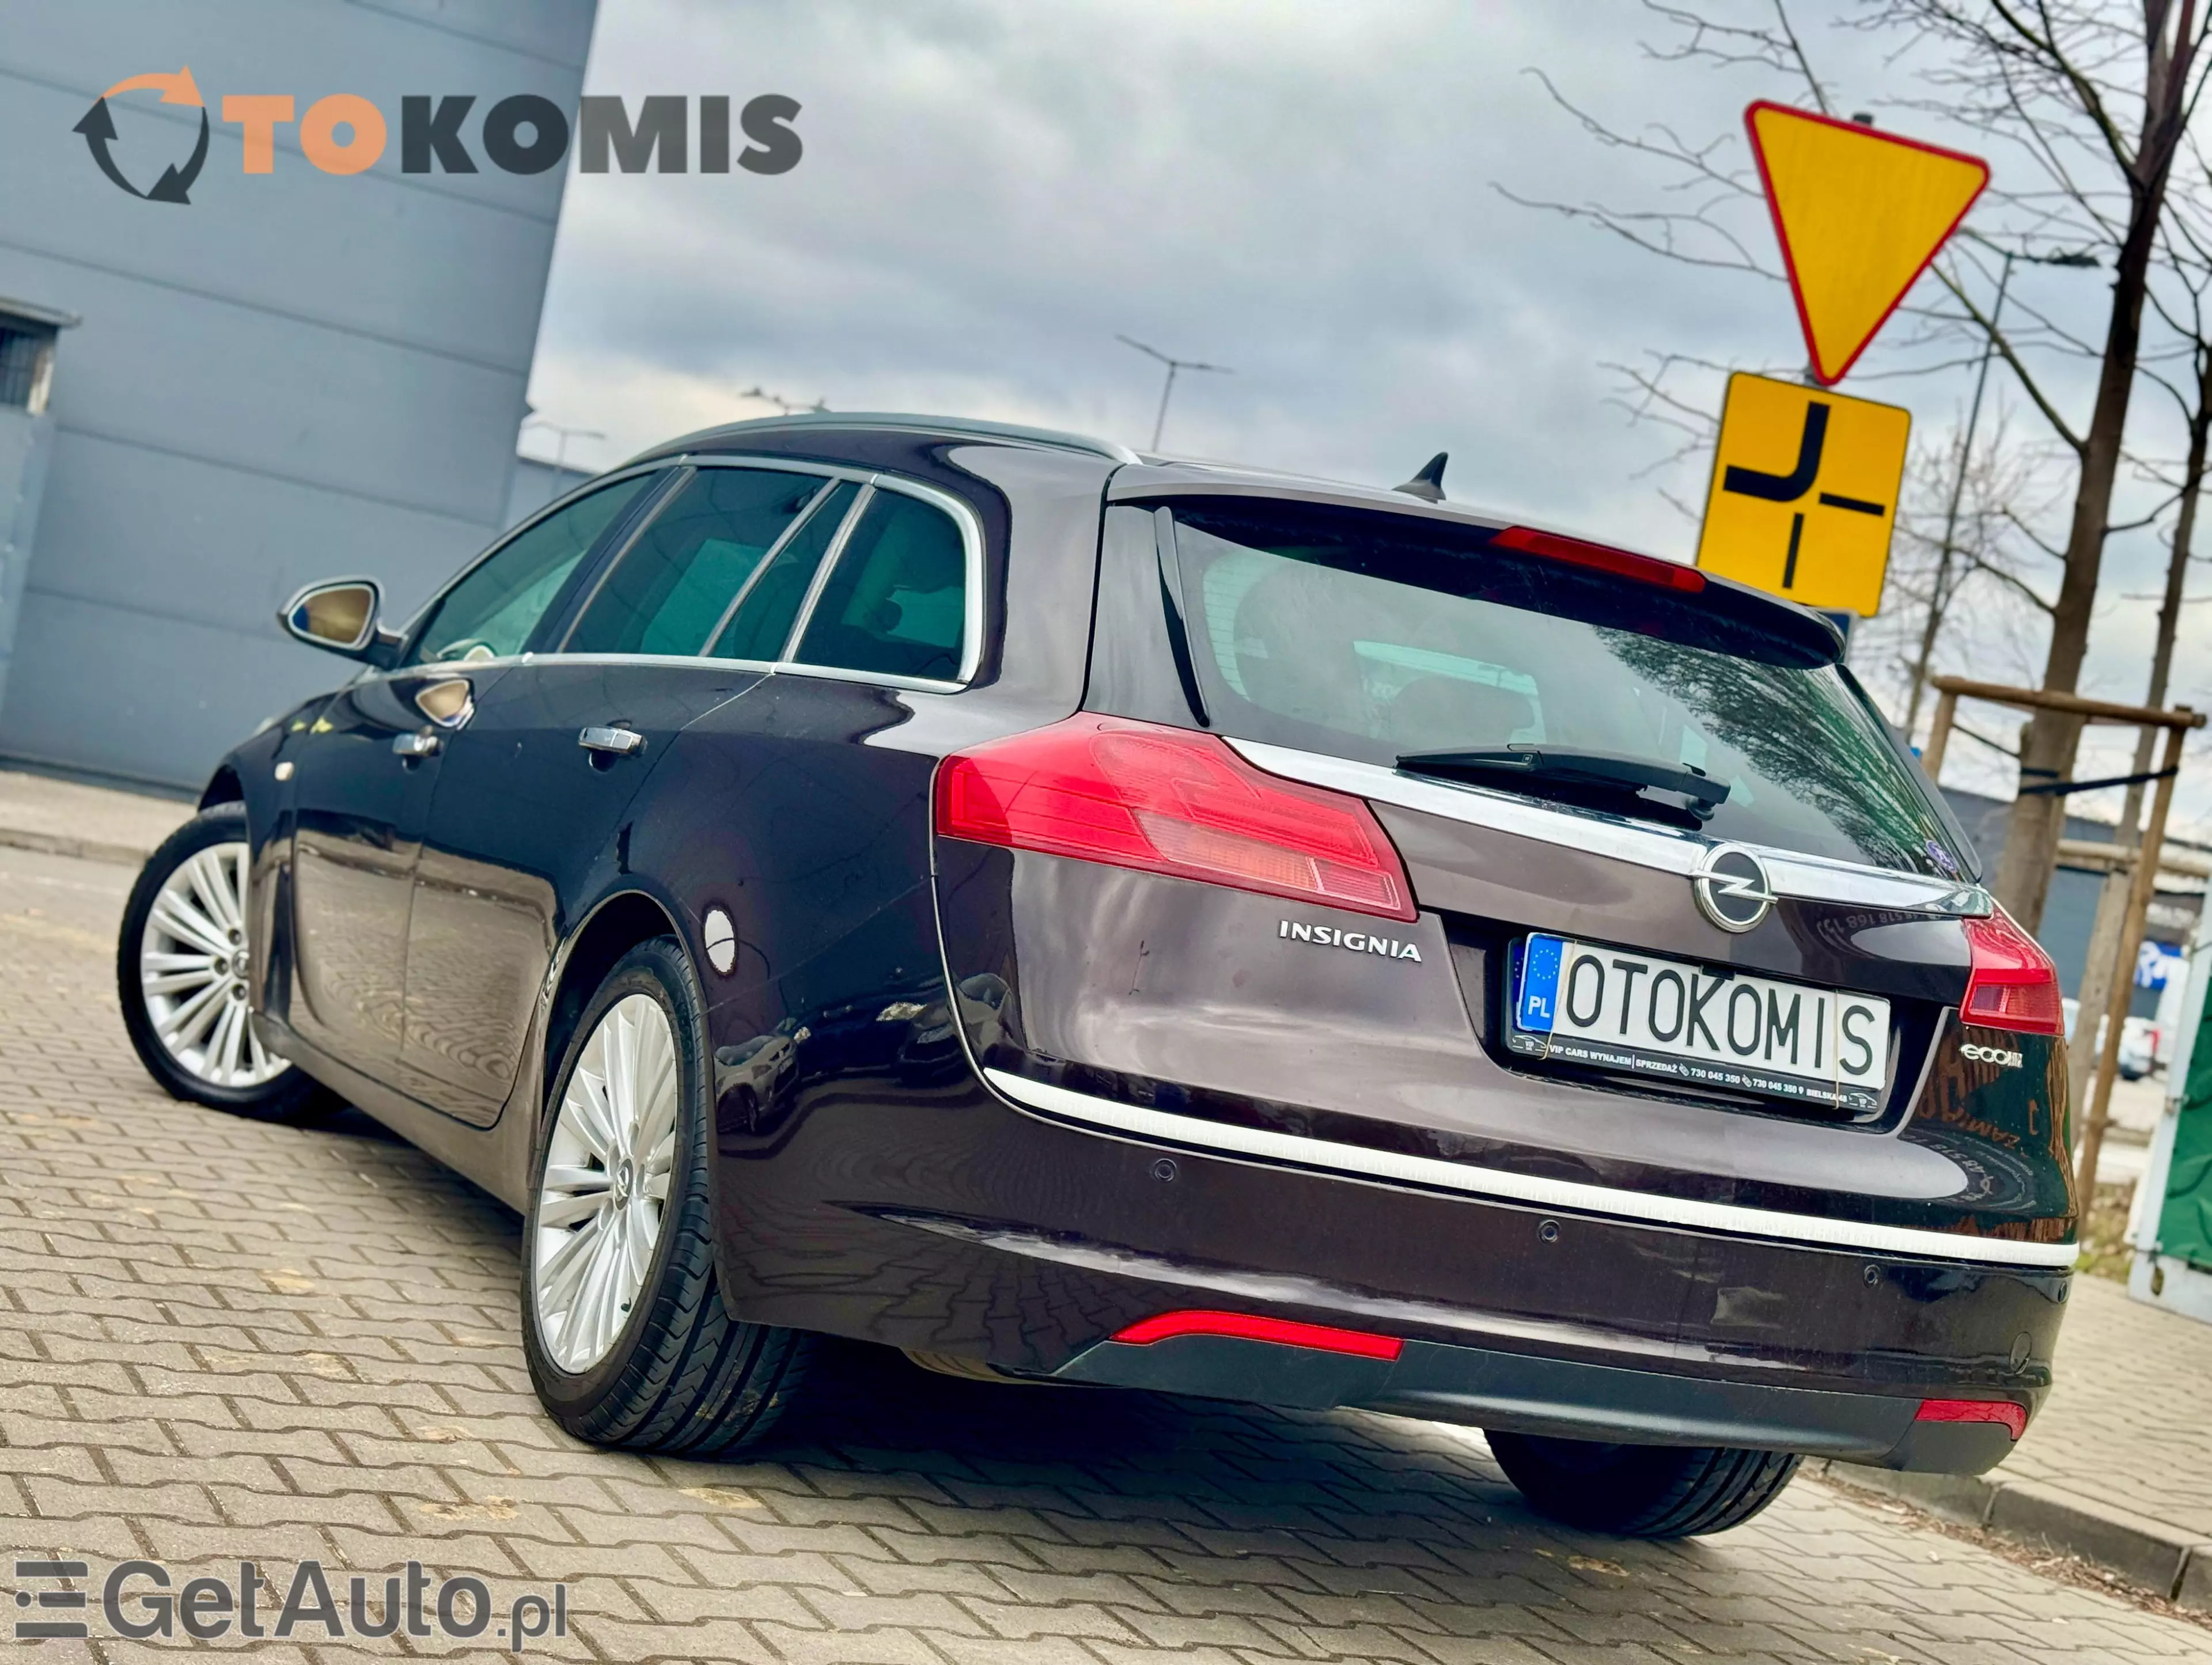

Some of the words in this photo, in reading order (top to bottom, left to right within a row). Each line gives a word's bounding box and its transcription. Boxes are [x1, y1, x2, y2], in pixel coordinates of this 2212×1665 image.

[1279, 920, 1422, 962] INSIGNIA
[1528, 995, 1550, 1018] PL
[1566, 954, 1876, 1075] OTOKOMIS
[1549, 1045, 1565, 1055] VIP
[1566, 1048, 1589, 1059] CARS
[1590, 1052, 1631, 1065] WYNAJEM
[1635, 1059, 1678, 1074] SPRZEDAŻ
[1691, 1068, 1706, 1078] 730
[1708, 1071, 1724, 1081] 045
[1725, 1074, 1740, 1084] 350
[1753, 1078, 1767, 1088] 730
[1768, 1081, 1782, 1091] 045
[1783, 1083, 1797, 1094] 350
